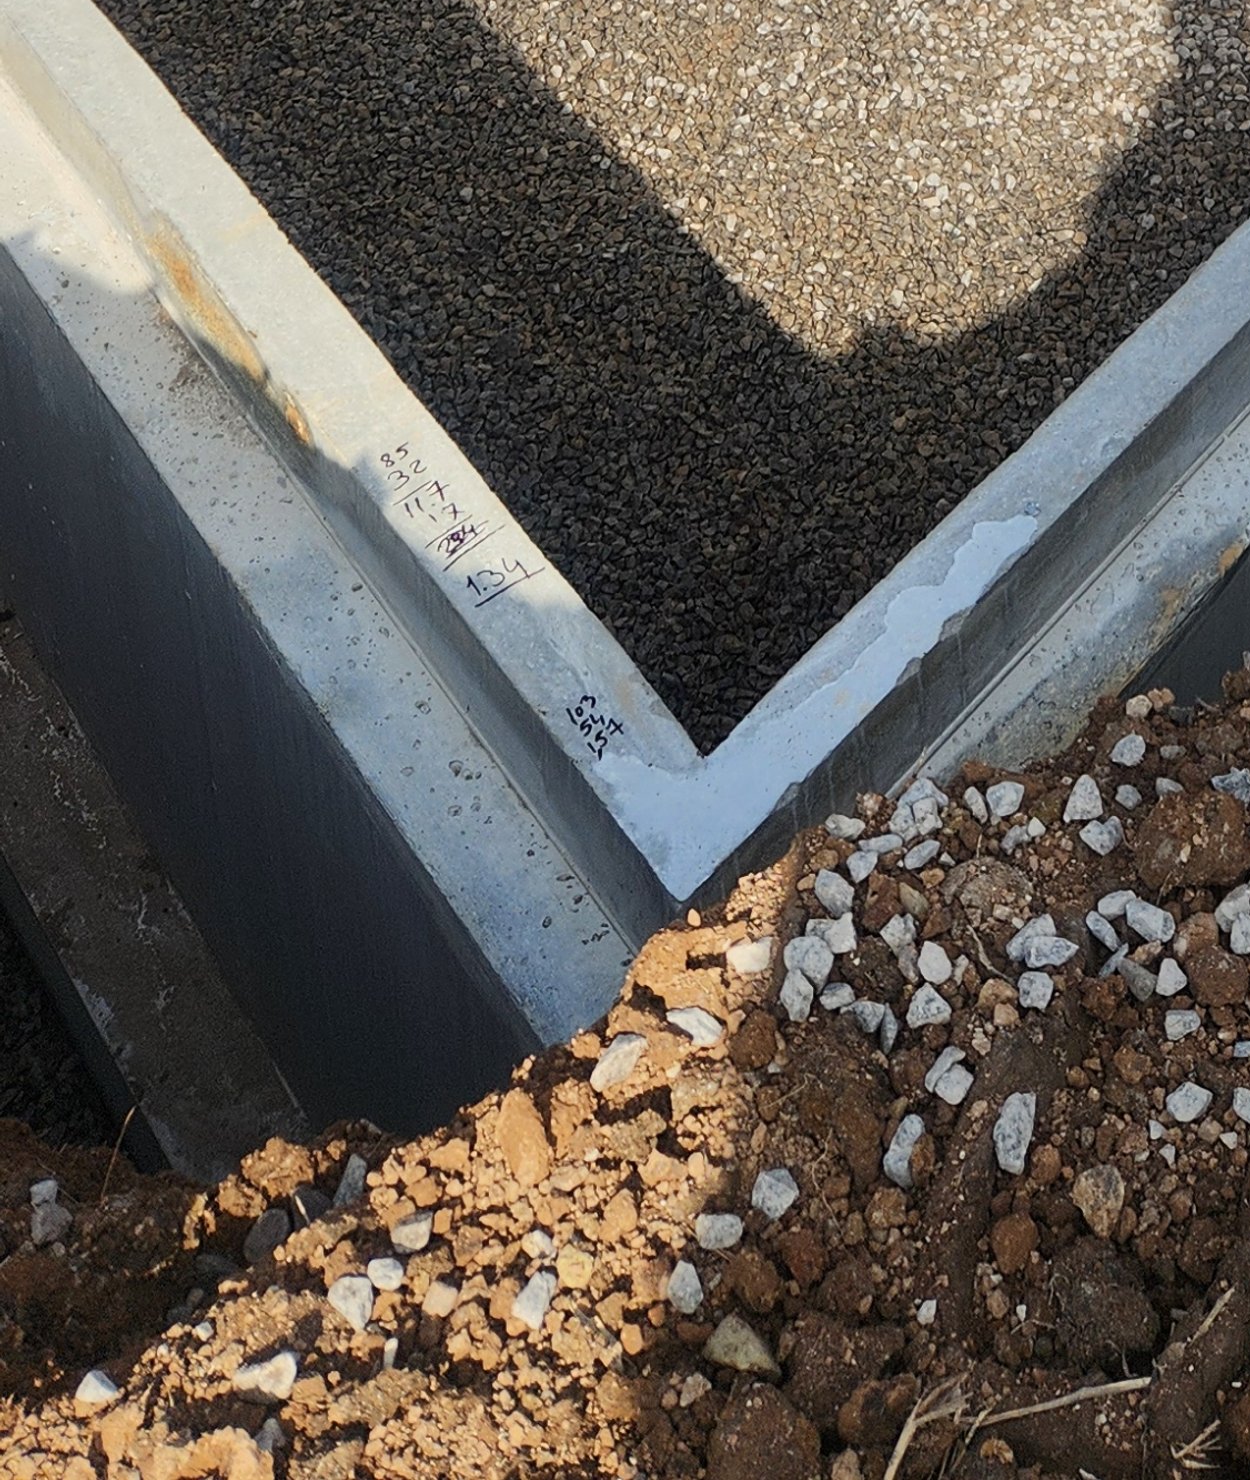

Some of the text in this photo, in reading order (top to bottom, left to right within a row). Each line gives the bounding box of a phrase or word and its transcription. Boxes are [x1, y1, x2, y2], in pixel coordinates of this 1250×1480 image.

[380, 441, 409, 468] 85
[387, 459, 428, 491] 32
[466, 557, 532, 597] 1.34
[565, 694, 597, 726] 103
[579, 713, 606, 738] 54
